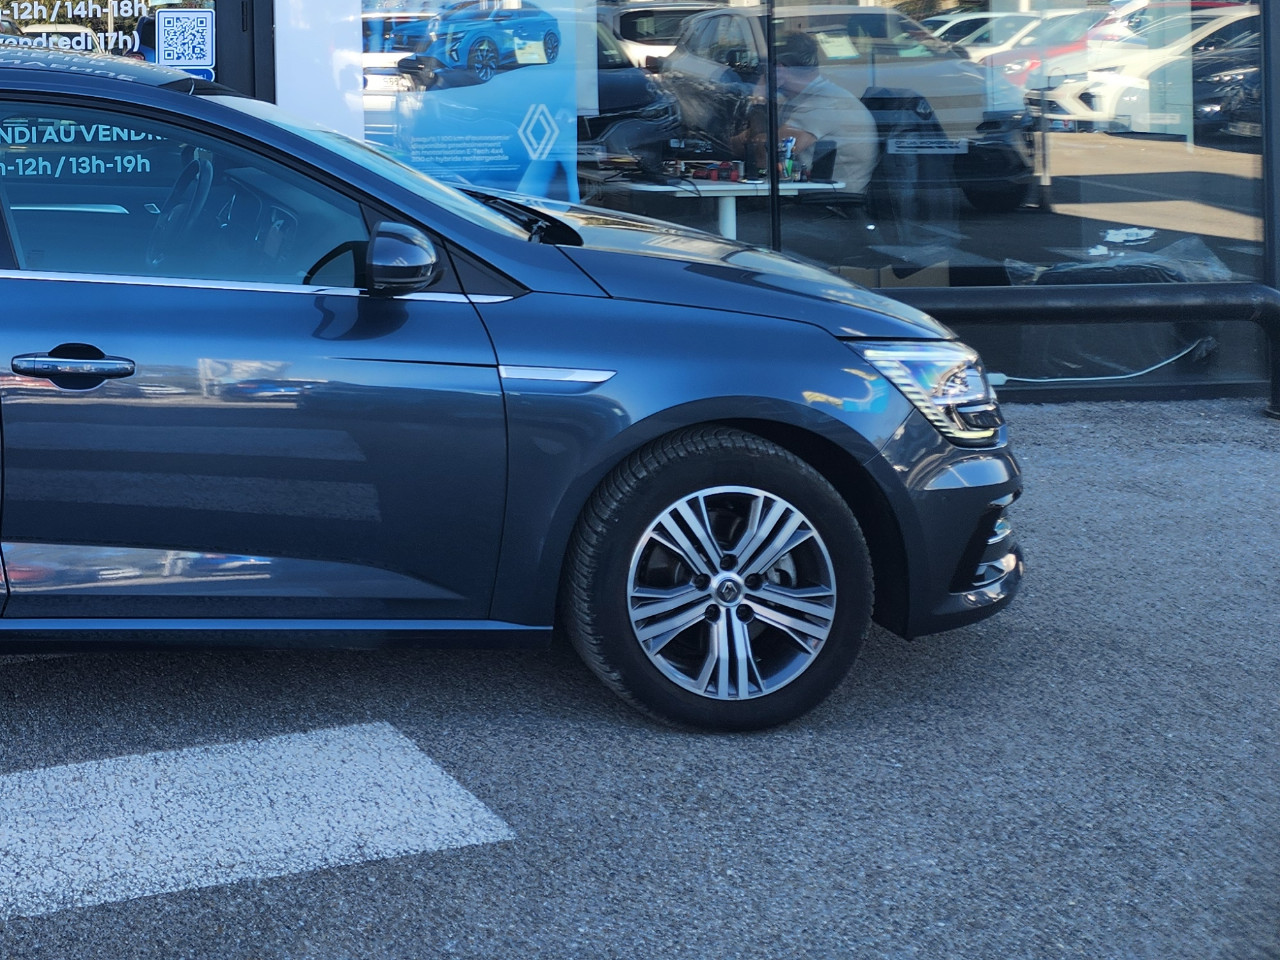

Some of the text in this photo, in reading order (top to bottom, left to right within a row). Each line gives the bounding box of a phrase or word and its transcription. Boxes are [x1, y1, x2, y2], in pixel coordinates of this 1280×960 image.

[96, 29, 140, 52] 17h)
[41, 125, 76, 144] AU
[69, 154, 151, 173] 13h-19h
